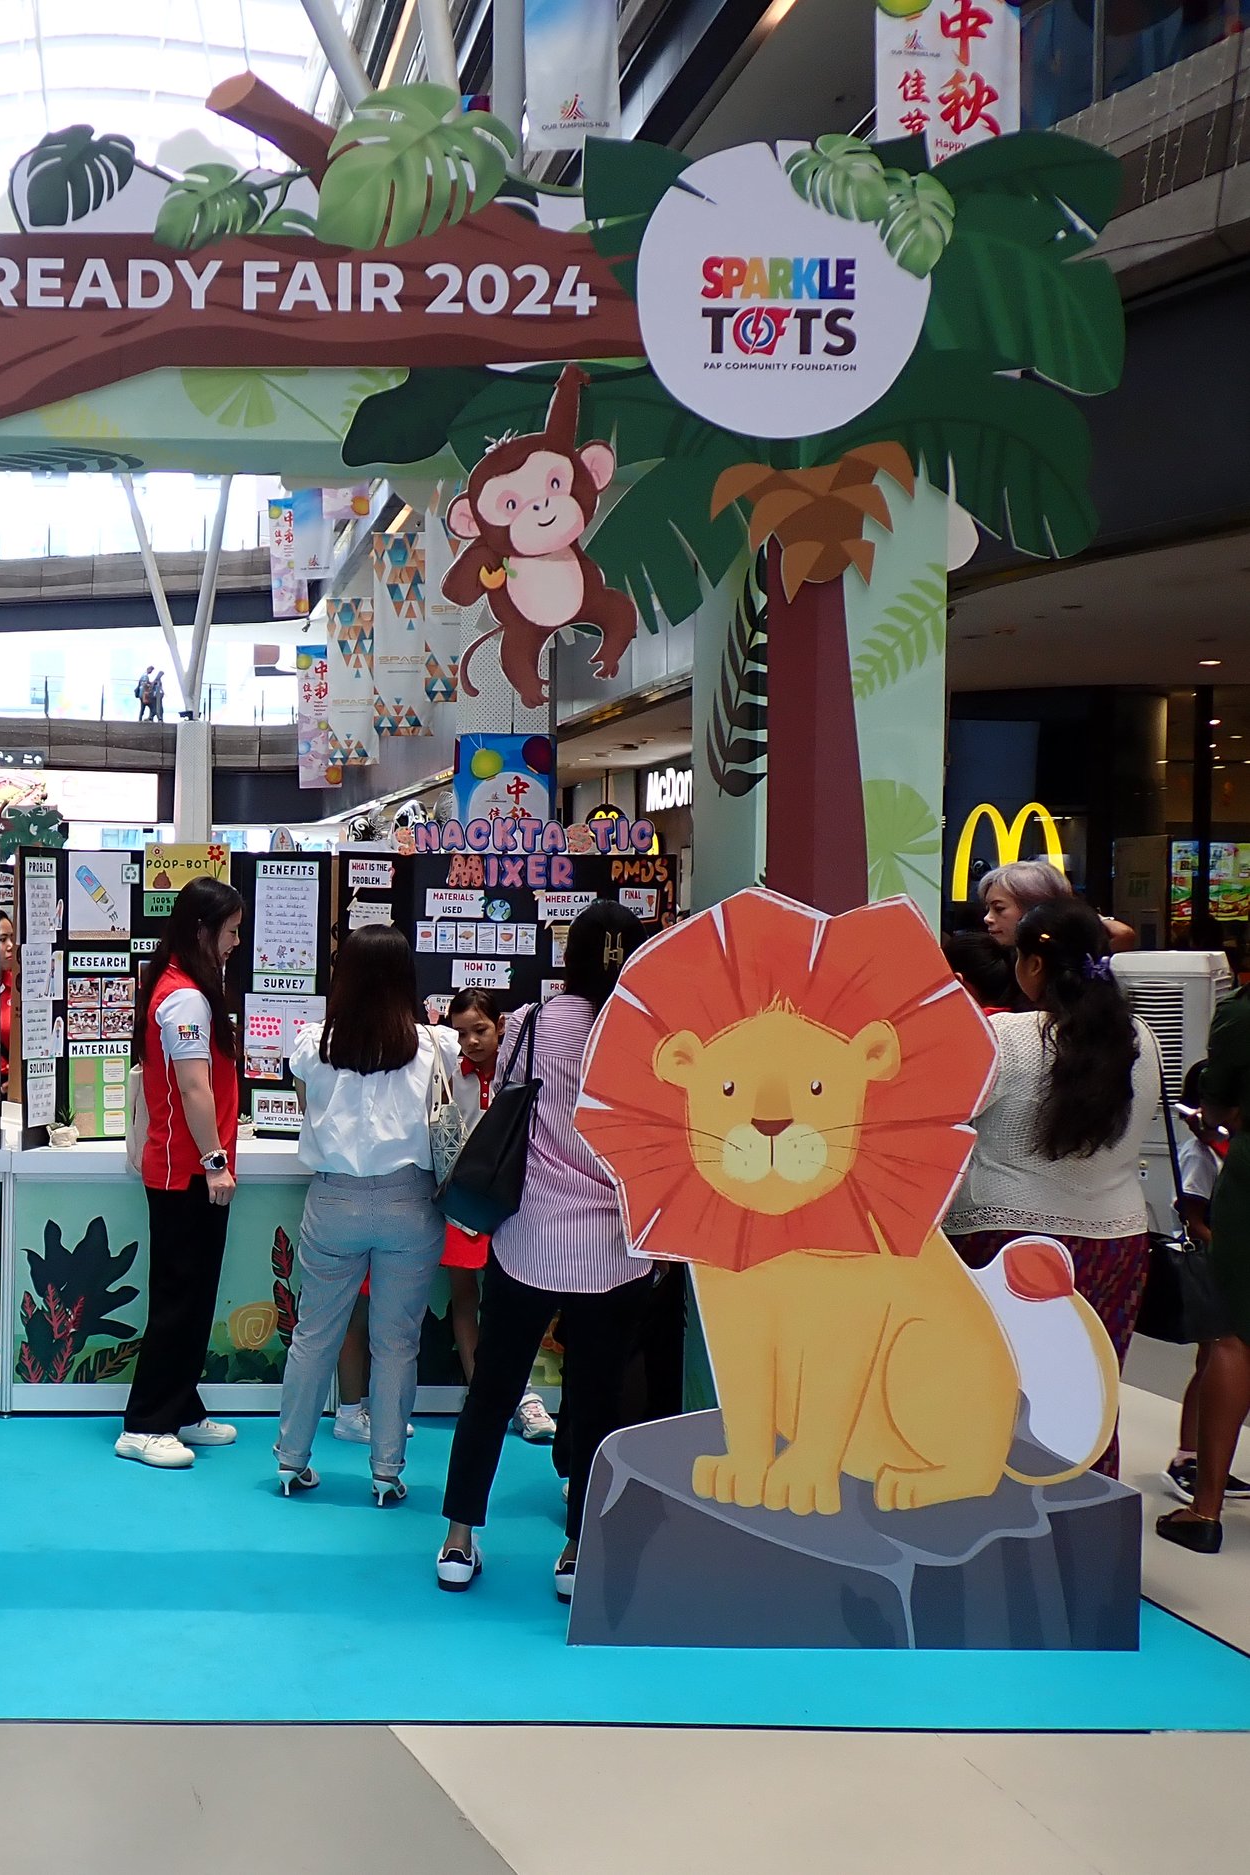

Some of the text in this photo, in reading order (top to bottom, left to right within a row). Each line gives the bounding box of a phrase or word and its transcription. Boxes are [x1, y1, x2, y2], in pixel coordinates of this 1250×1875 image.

[938, 0, 1002, 136] 中秋
[936, 139, 967, 151] Happy
[701, 256, 856, 300] SPARKLE
[243, 260, 405, 313] FAIR
[424, 262, 598, 316] 2024
[703, 361, 857, 372] PAP COMMUNITY FOUNDATION
[646, 767, 693, 812] McDon
[395, 817, 655, 856] SNACKTASTIC
[29, 861, 54, 873] PROBLEM
[146, 859, 210, 869] POOP-BOT
[351, 862, 368, 871] WHAT
[369, 863, 375, 871] IS
[376, 864, 388, 872] THE
[262, 864, 315, 876] BENEFITS
[447, 852, 574, 889] MIXER
[352, 876, 380, 885] PROBLEM
[433, 892, 474, 901] MATERIALS
[545, 895, 590, 903] WHERE CAN
[624, 890, 642, 900] FINAL
[442, 906, 463, 914] USED
[547, 908, 575, 917] WE USE
[72, 956, 127, 968] RESEARCH
[464, 962, 496, 971] HOW TO
[263, 978, 305, 989] SURVEY
[465, 978, 482, 986] USE
[484, 978, 496, 987] IT?
[71, 1044, 129, 1055] MATERIALS
[29, 1062, 54, 1074] SOLUTION
